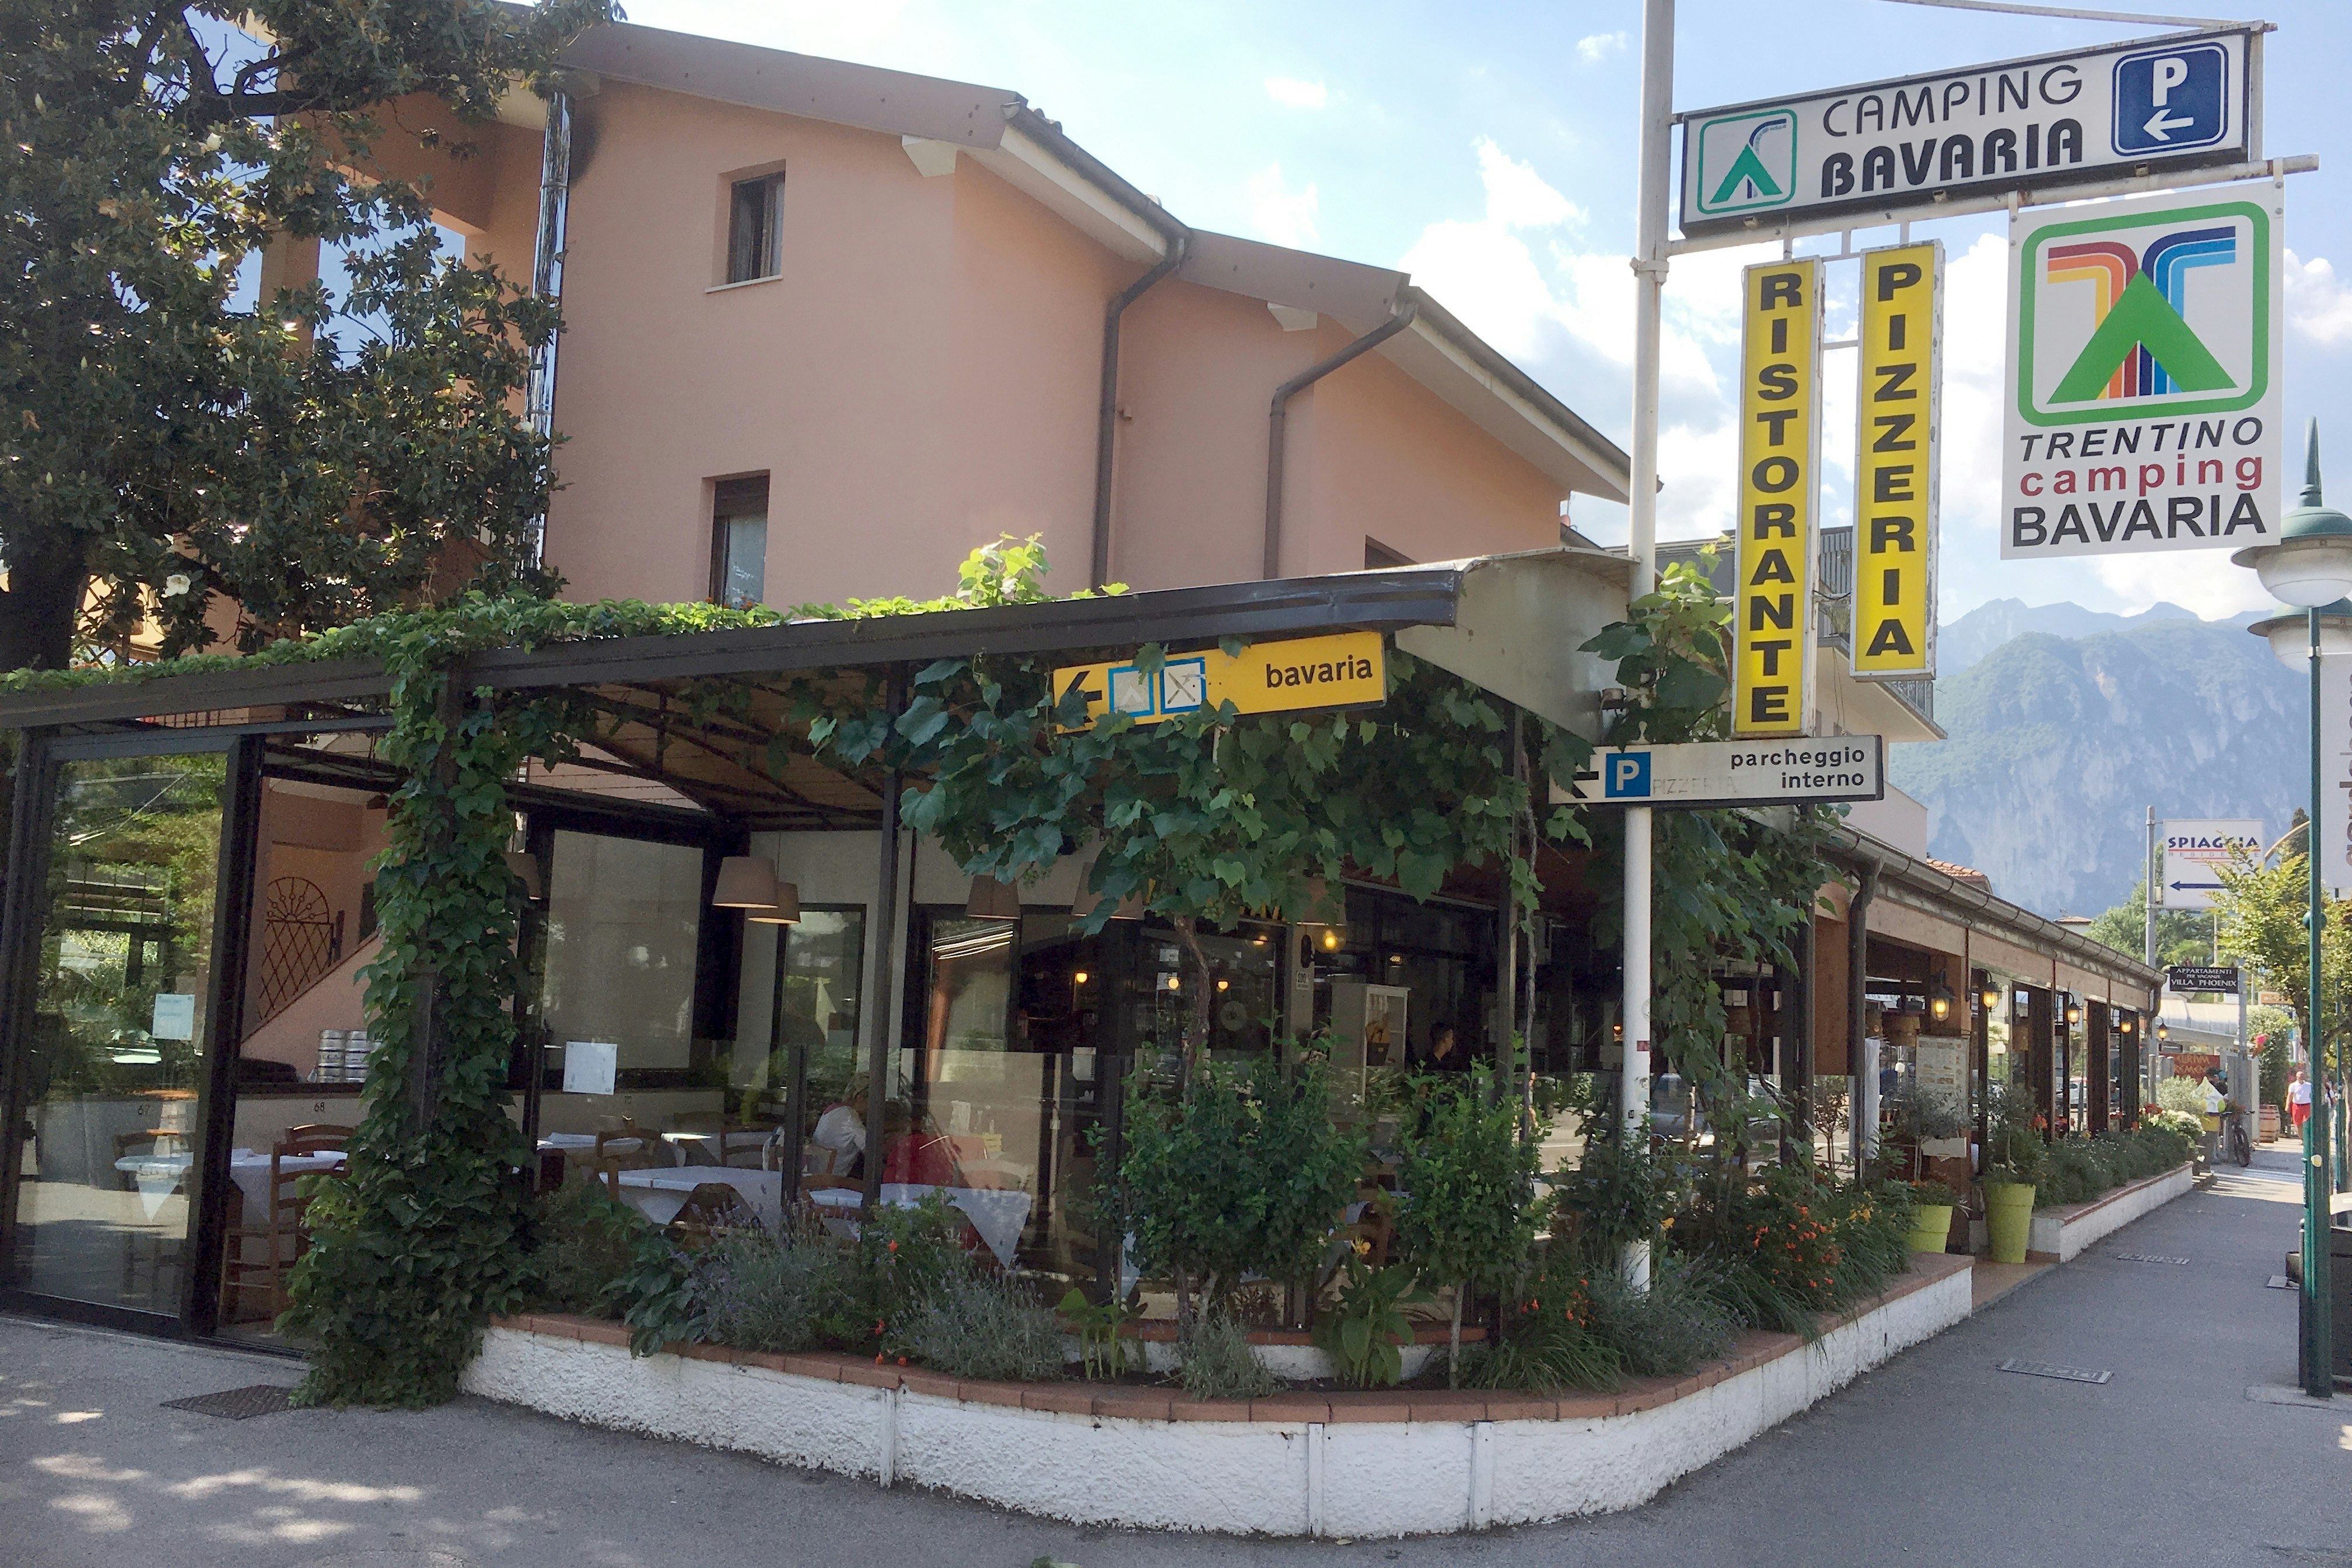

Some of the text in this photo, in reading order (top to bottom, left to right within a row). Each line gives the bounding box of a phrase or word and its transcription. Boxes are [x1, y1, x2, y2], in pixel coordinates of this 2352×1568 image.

[1822, 64, 2082, 137] CAMPING
[2152, 57, 2188, 107] P
[1821, 118, 2083, 198] BAVARIA
[1864, 262, 1923, 657] PIZZERIA
[2020, 416, 2263, 462] TRENTINO
[1749, 272, 1803, 723] RISTORANTE
[2020, 453, 2263, 497] camping
[2013, 492, 2267, 547] BAVARIA
[1265, 654, 1373, 688] bavaria
[1616, 760, 1640, 790] P
[1731, 746, 1865, 770] parcheggio
[1781, 772, 1864, 789] interno
[314, 1101, 325, 1112] 68
